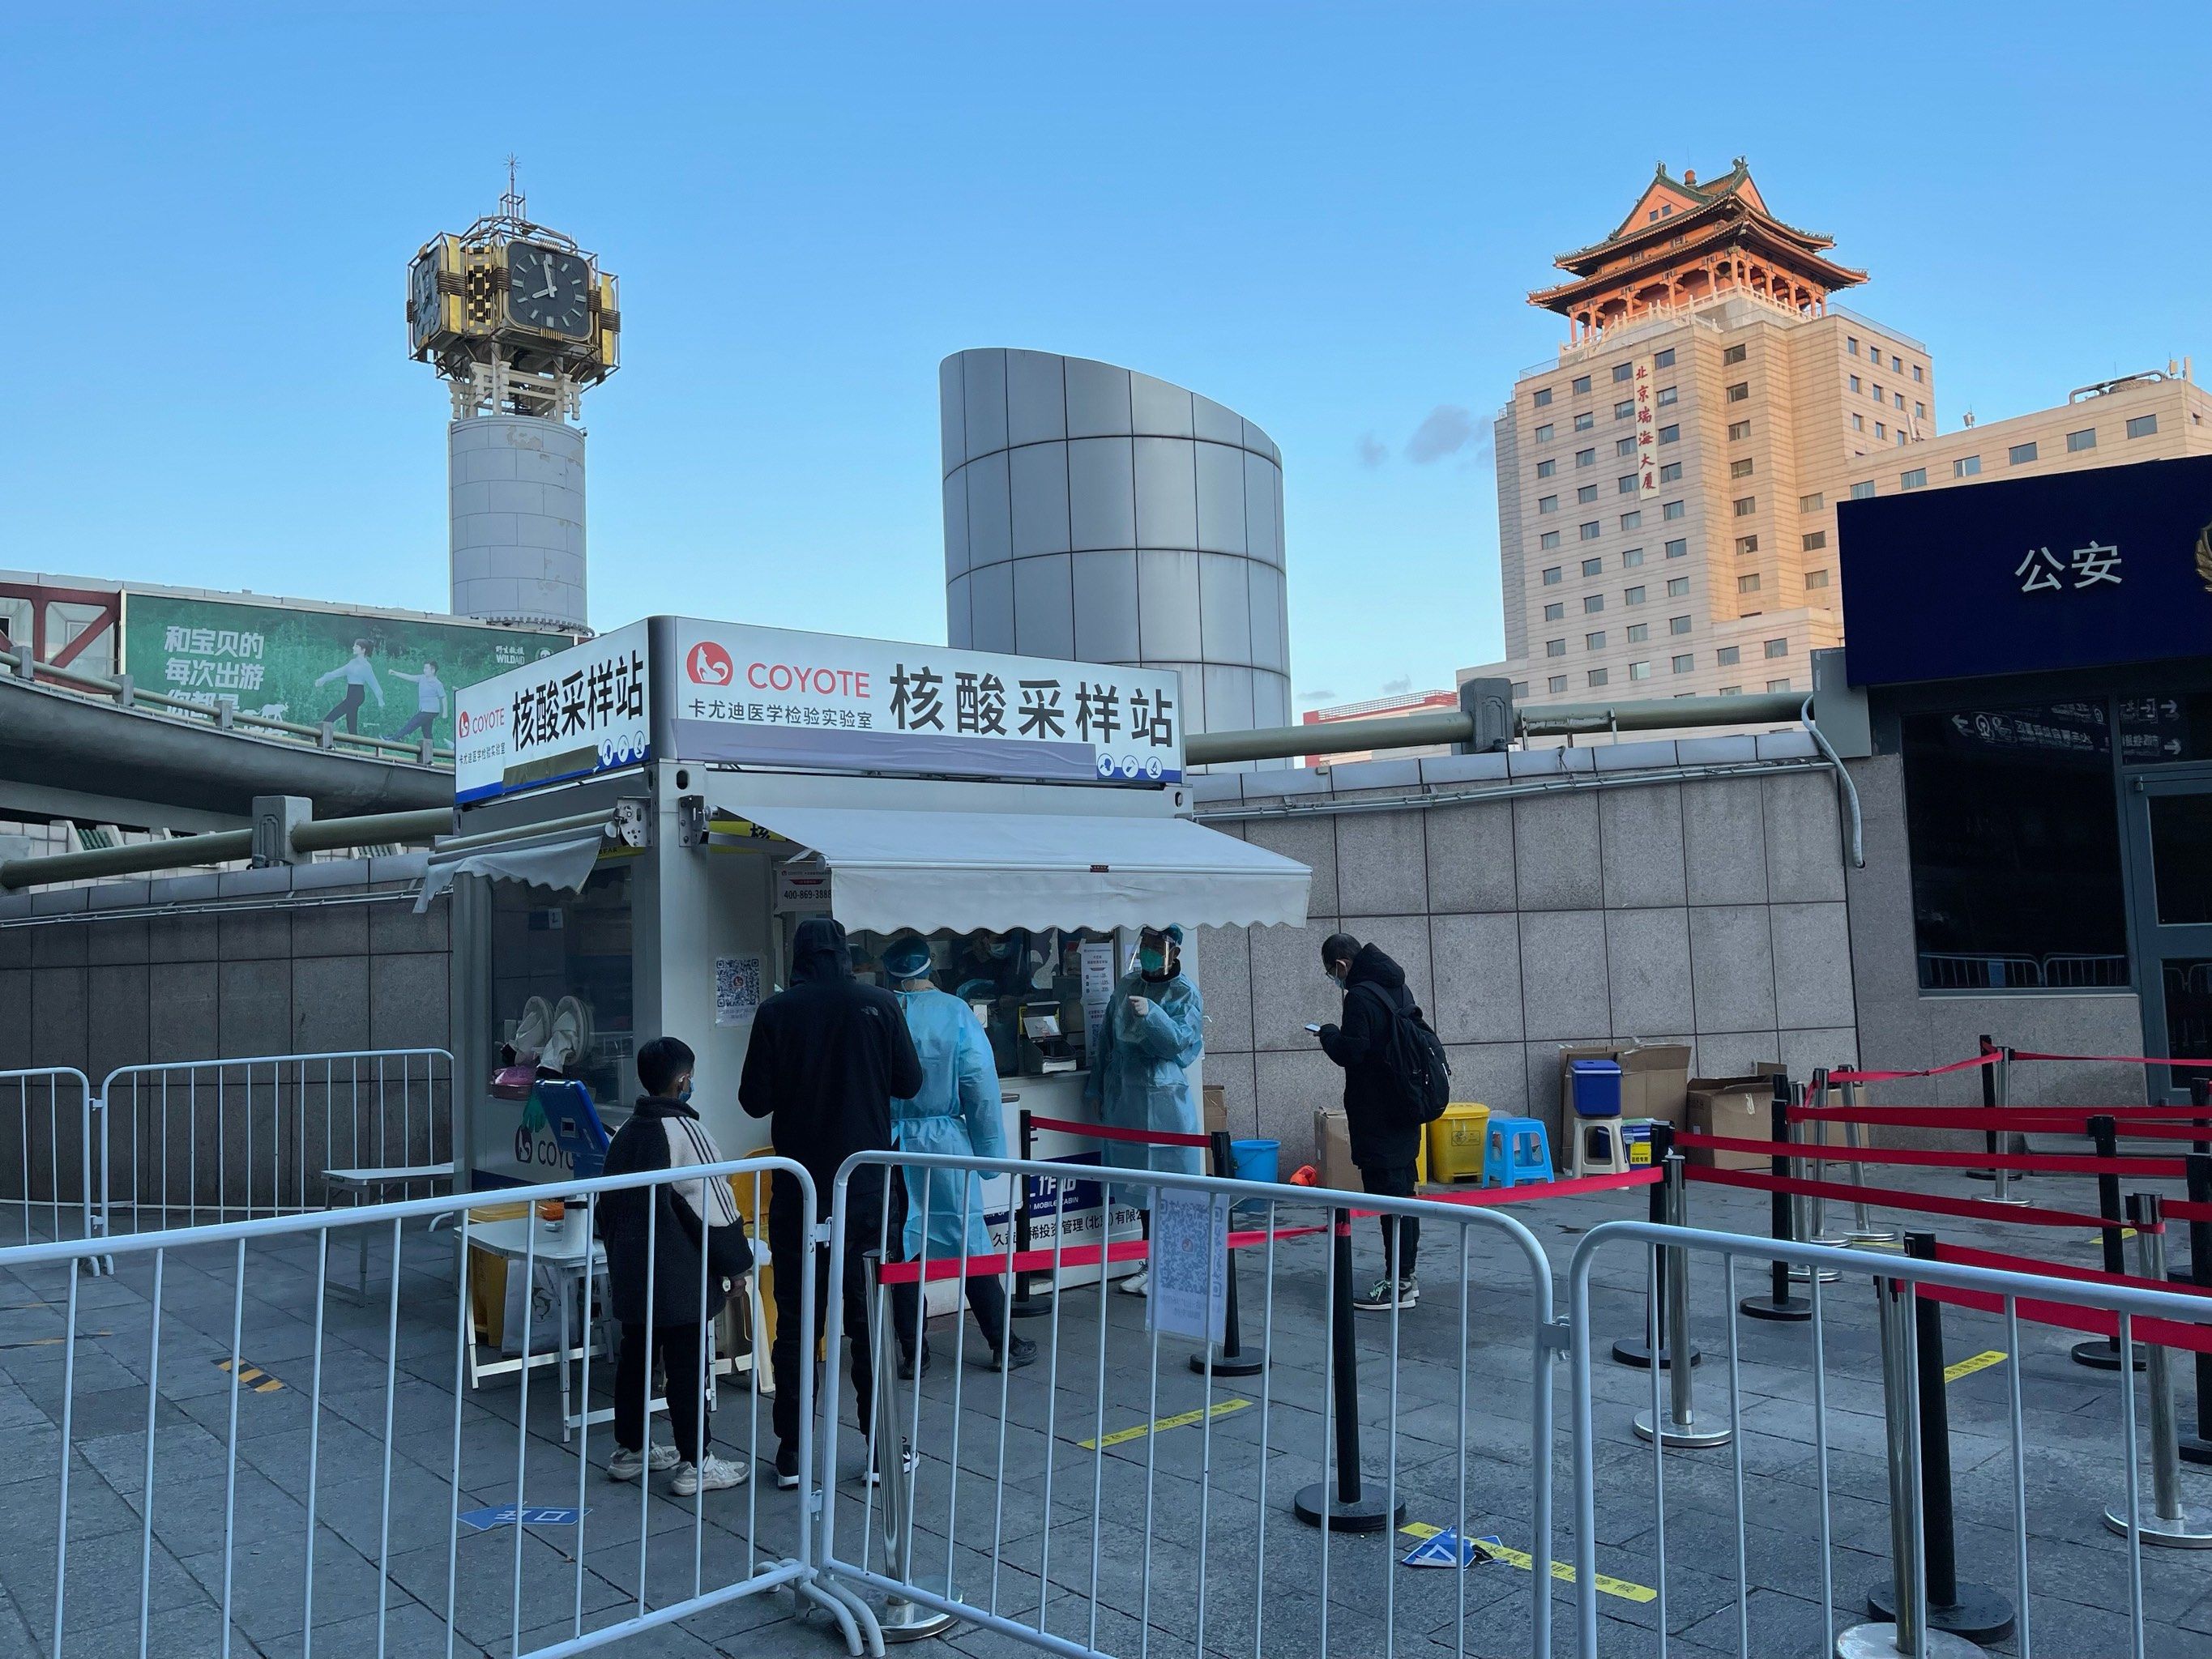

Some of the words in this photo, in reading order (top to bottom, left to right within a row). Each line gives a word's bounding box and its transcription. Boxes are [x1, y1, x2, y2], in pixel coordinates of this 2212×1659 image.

[1635, 365, 1656, 489] 北京瑞海大厦
[2014, 540, 2123, 593] 公安
[164, 625, 265, 659] 和宝贝的
[164, 657, 265, 690] 每次出游
[496, 654, 525, 665] WILDAID
[747, 662, 871, 698] COYOTE
[512, 649, 643, 752] 核酸采样站
[688, 697, 873, 729] 卡尤迪医学检验实验室
[889, 663, 1173, 748] 核酸采样站
[472, 708, 505, 735] COYOTE
[1033, 1200, 1057, 1210] MOBILE
[1061, 1196, 1079, 1206] ABIN
